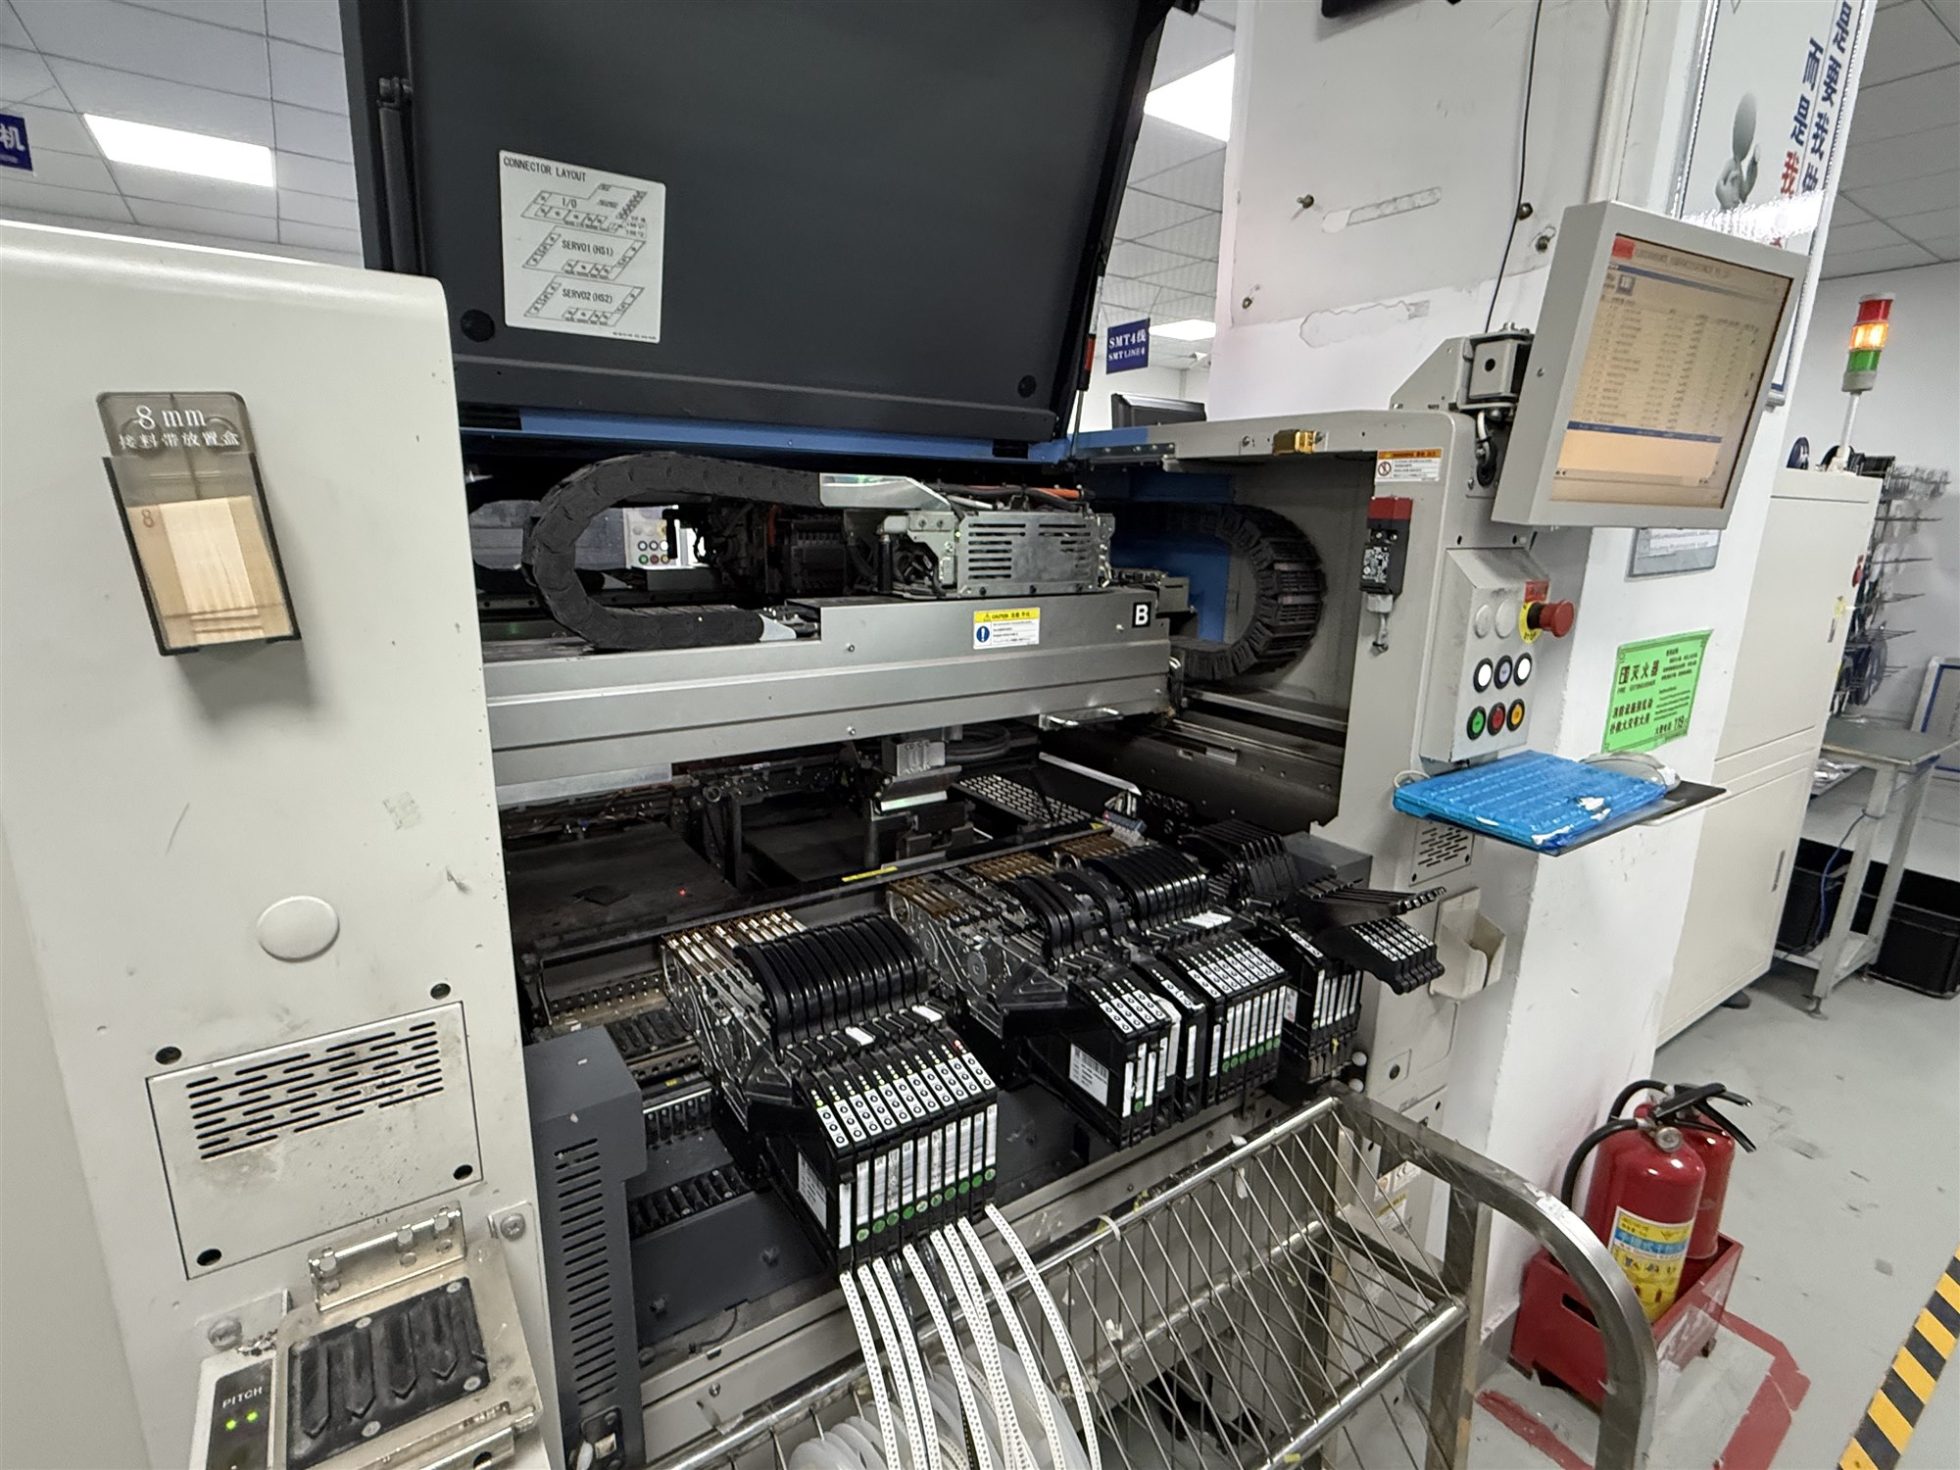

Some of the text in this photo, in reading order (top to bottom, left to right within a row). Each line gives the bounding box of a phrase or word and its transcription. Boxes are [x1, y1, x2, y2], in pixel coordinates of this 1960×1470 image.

[503, 156, 586, 182] CONNECTOR LAYOUT
[561, 198, 577, 209] I/O
[135, 405, 207, 430] 8 mm
[118, 430, 241, 450] 接料带放置盒
[141, 509, 155, 528] 8
[1135, 604, 1149, 626] B
[1630, 660, 1660, 682] 灭火器
[222, 1386, 263, 1408] PITCH
